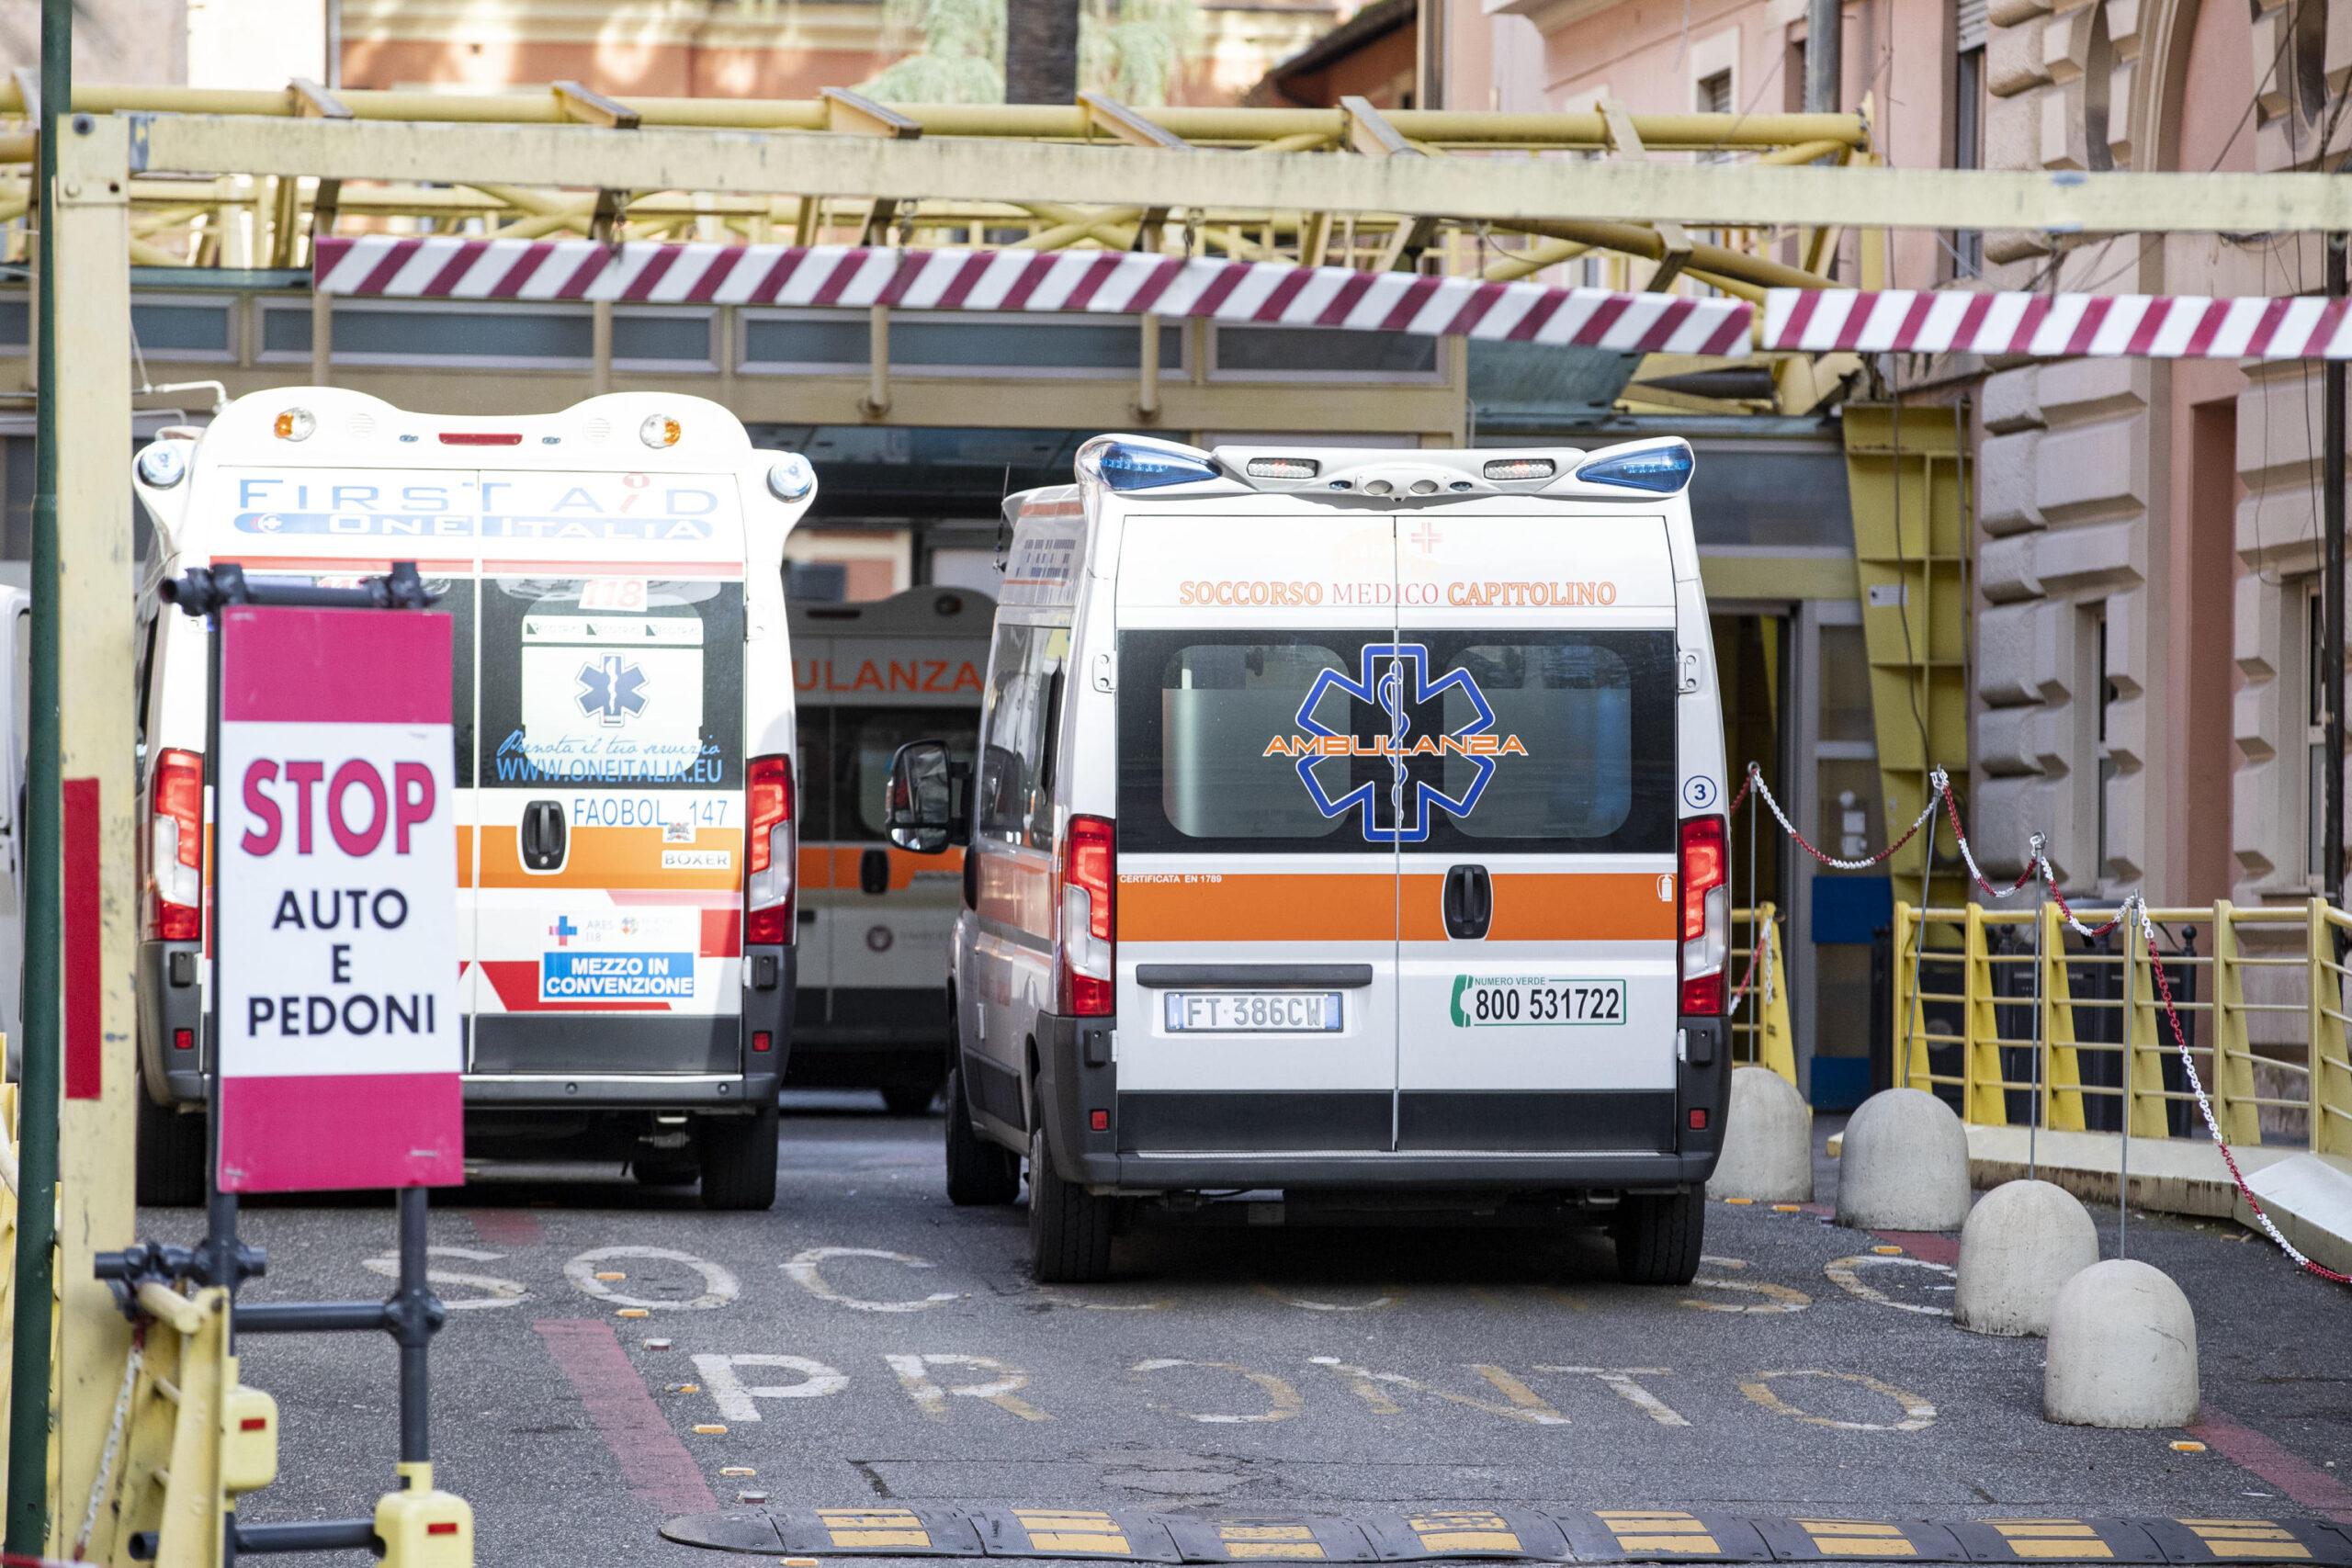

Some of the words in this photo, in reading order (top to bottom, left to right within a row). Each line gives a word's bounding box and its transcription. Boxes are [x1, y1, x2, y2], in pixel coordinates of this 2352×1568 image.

[240, 479, 512, 513] FIRST
[329, 514, 470, 536] ONE
[503, 517, 707, 540] ITALIA
[1180, 581, 1323, 605] SOCCORSO
[1332, 582, 1439, 604] MEDICO
[1447, 581, 1617, 606] CAPITOLINO
[605, 735, 637, 755] tuo
[1262, 735, 1529, 756] AMBULANZA
[496, 758, 723, 783] WWW.ONEITALIA.EU
[1694, 784, 1706, 800] 3
[241, 759, 435, 857] STOP
[573, 798, 667, 826] FAOBOL
[689, 800, 728, 826] 147
[664, 853, 729, 866] BOXER
[1119, 874, 1181, 884] CERTIFICATA
[1184, 874, 1198, 884] EN
[1200, 874, 1223, 884] 1789
[272, 888, 408, 930] AUTO
[332, 944, 351, 983] E
[571, 957, 643, 976] MEZZO
[648, 957, 669, 976] IN
[546, 976, 694, 995] CONVENZIONE
[1475, 976, 1513, 986] NUMERO
[1516, 976, 1546, 986] VERDE
[248, 994, 435, 1036] PEDONI
[1187, 998, 1221, 1026] FT
[1234, 998, 1321, 1026] 386CW
[1476, 988, 1520, 1020] 800
[1530, 988, 1619, 1019] 531722
[689, 1353, 1939, 1432] PRONTO
